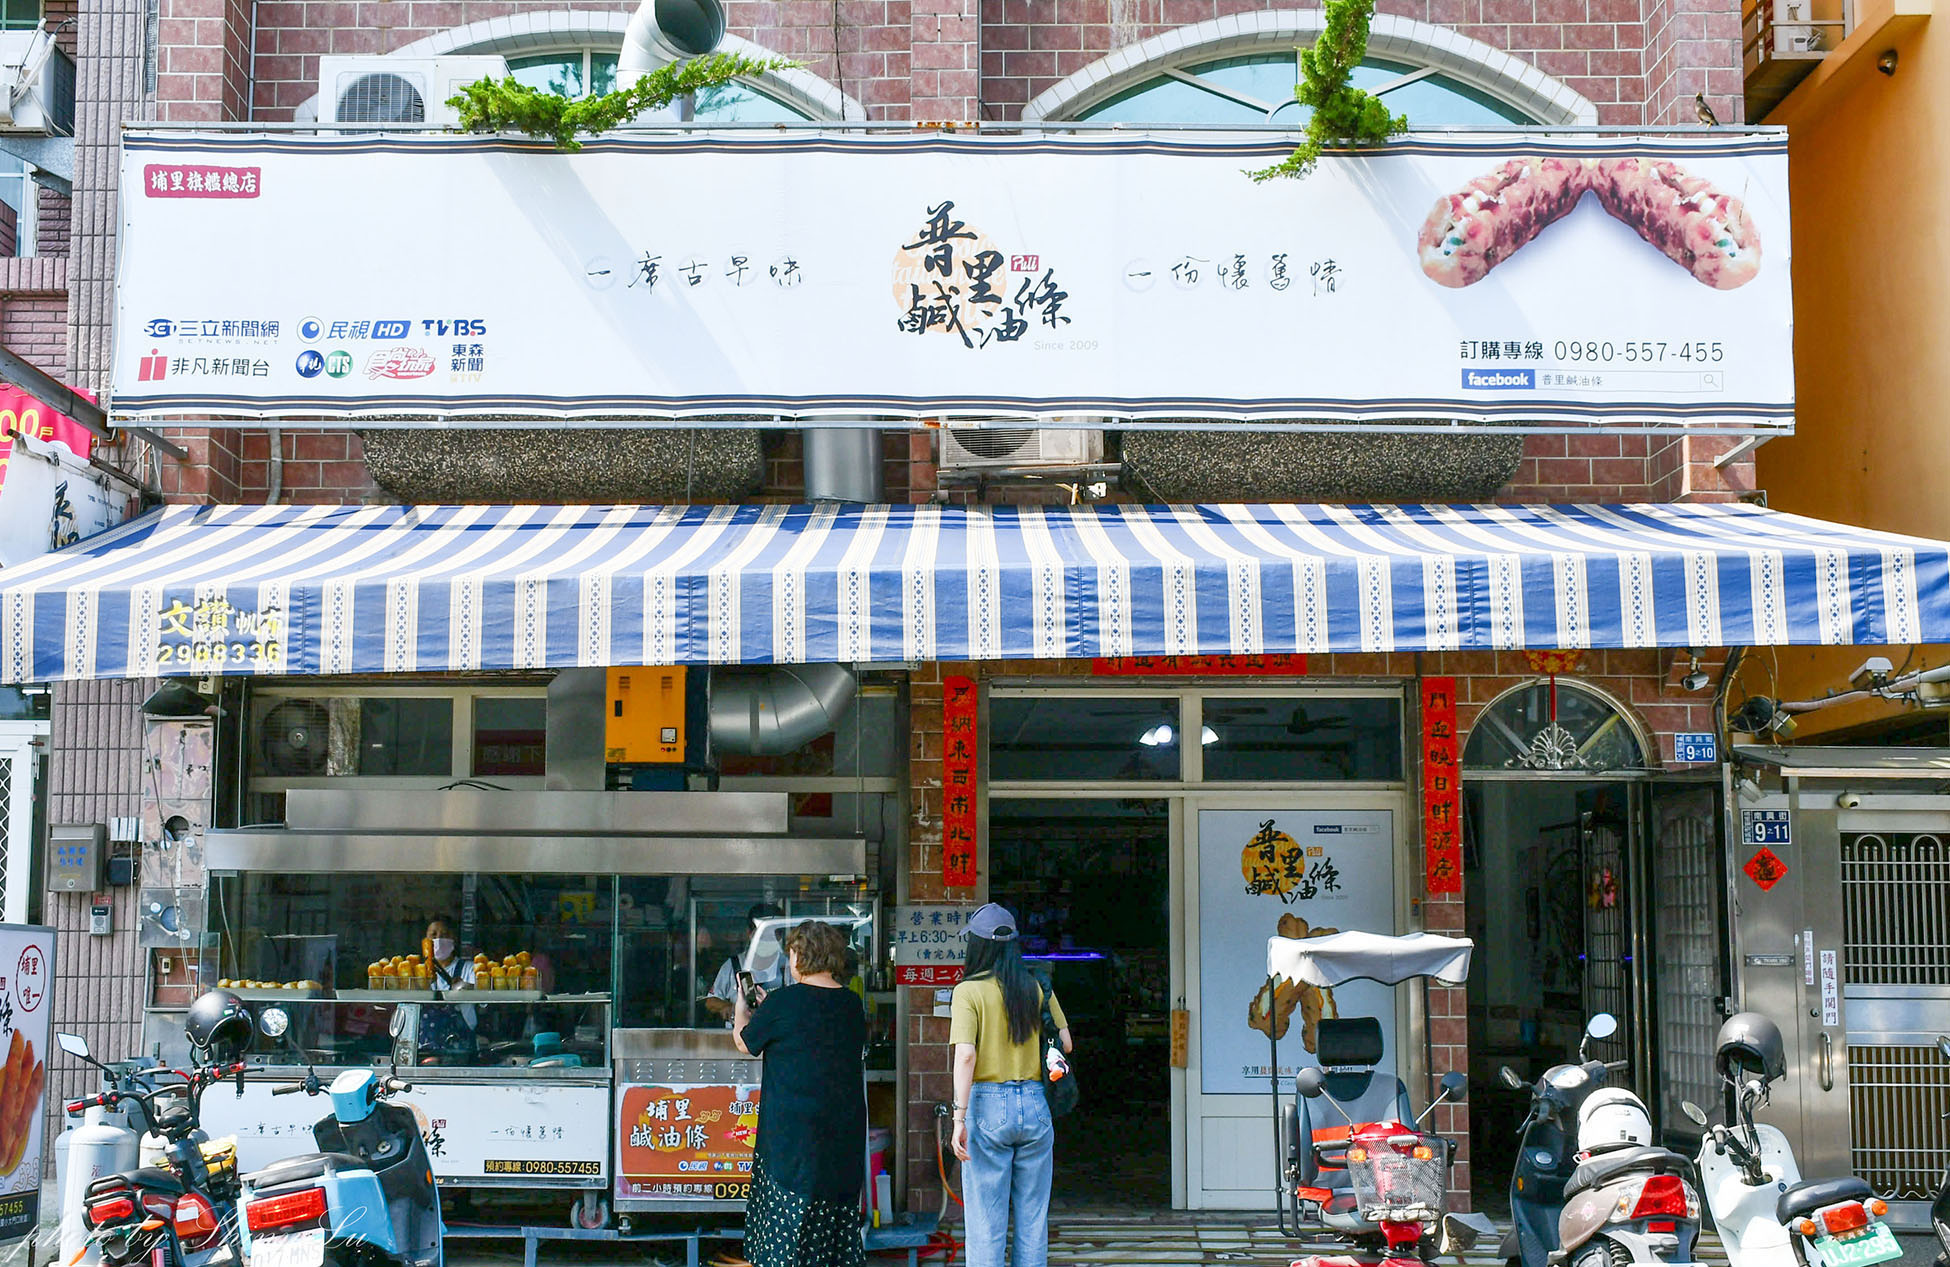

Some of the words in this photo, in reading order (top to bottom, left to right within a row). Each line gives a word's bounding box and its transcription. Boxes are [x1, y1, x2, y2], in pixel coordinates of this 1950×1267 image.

[150, 169, 258, 194] 埔里旗艦總店
[587, 250, 803, 295] 一席古早味
[178, 320, 280, 338] 三立新聞網
[326, 320, 371, 340] 民視
[377, 323, 404, 337] HD
[422, 319, 487, 337] TVBS
[451, 343, 485, 357] 東森
[1033, 340, 1064, 351] Since
[1069, 340, 1099, 351] 2009
[1460, 340, 1544, 360] 訂購專線
[1553, 341, 1725, 362] 0980-557-455
[171, 357, 270, 377] 非凡新聞台
[328, 356, 351, 374] CTS
[450, 357, 485, 373] 新聞
[1467, 373, 1530, 386] facebook
[646, 1098, 692, 1122] 埔里
[630, 1123, 710, 1151] 鹹油條
